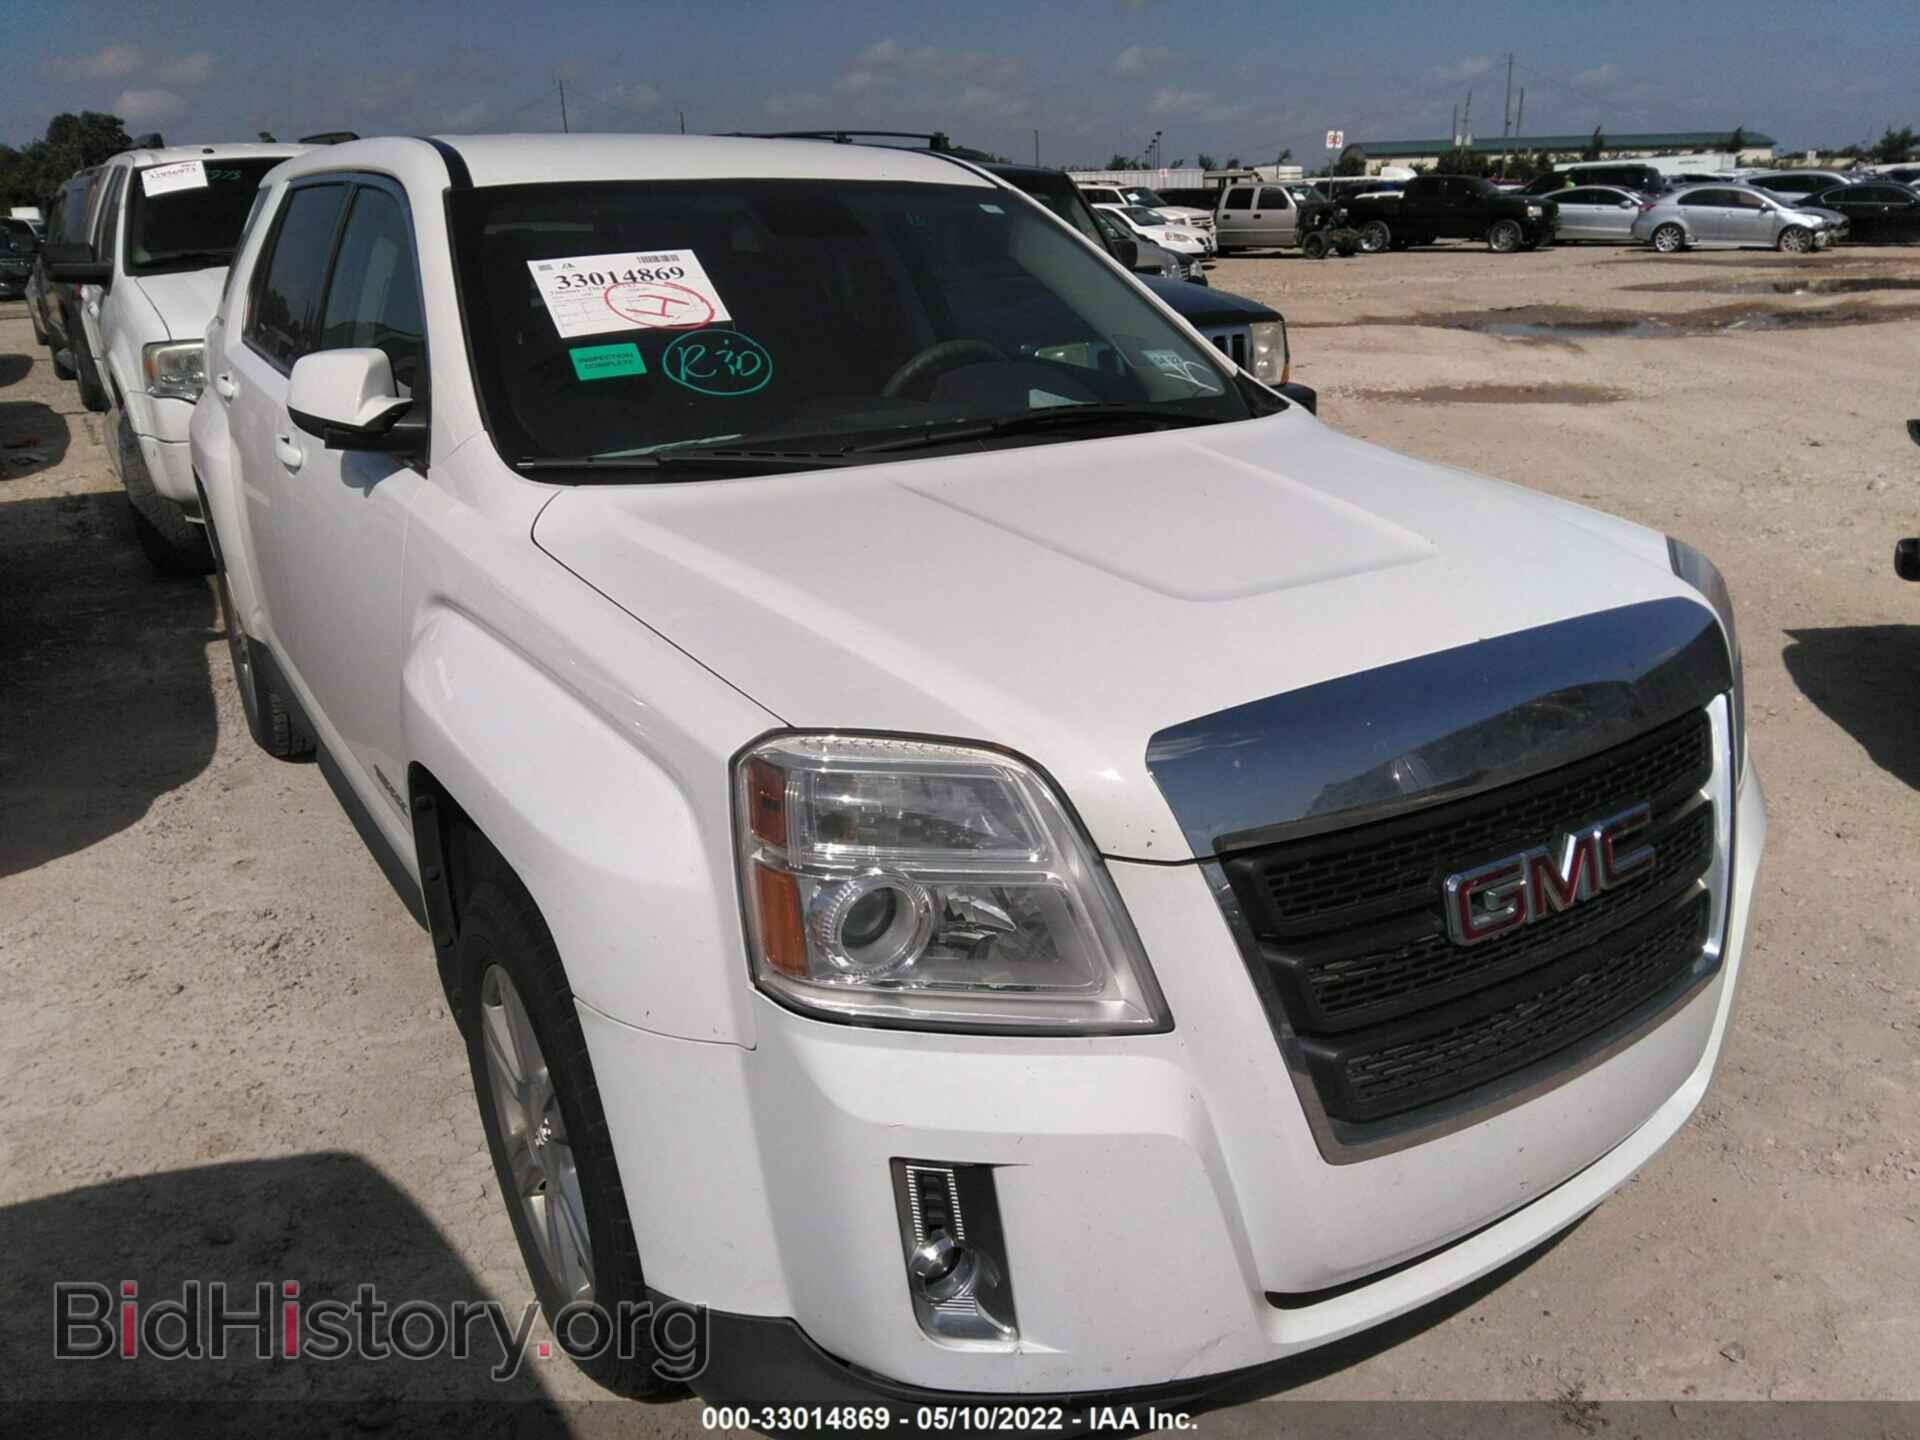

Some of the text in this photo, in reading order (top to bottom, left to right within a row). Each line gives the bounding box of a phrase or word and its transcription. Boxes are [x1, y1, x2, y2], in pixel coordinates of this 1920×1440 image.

[554, 265, 686, 290] 33014869
[578, 351, 634, 364] INSPECTION
[584, 359, 633, 370] COMPLETE
[1443, 800, 1656, 947] GMC
